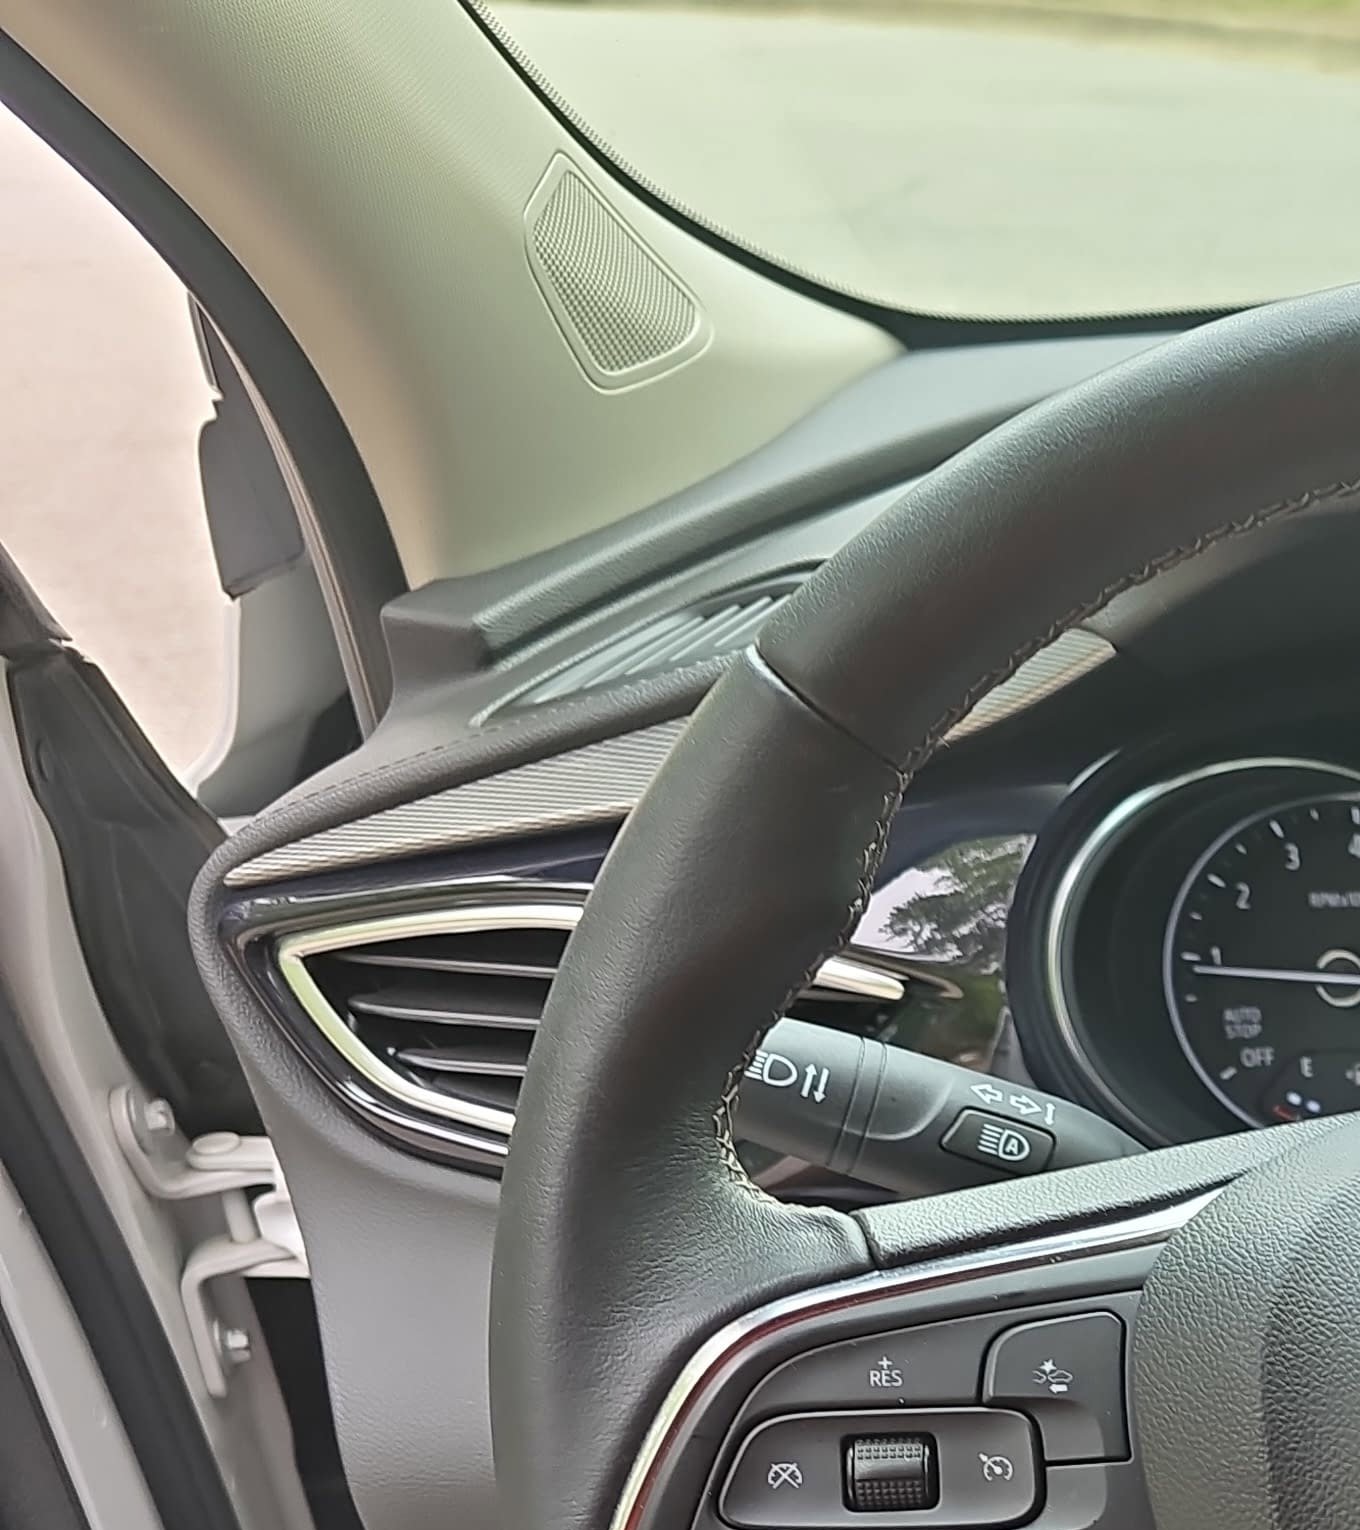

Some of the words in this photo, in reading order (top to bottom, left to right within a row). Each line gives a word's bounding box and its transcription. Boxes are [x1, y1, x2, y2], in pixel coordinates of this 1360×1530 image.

[1286, 843, 1300, 870] 3
[1236, 883, 1250, 909] 2
[1241, 1046, 1275, 1067] OFF
[1301, 1057, 1312, 1077] E
[870, 1370, 902, 1387] RES
